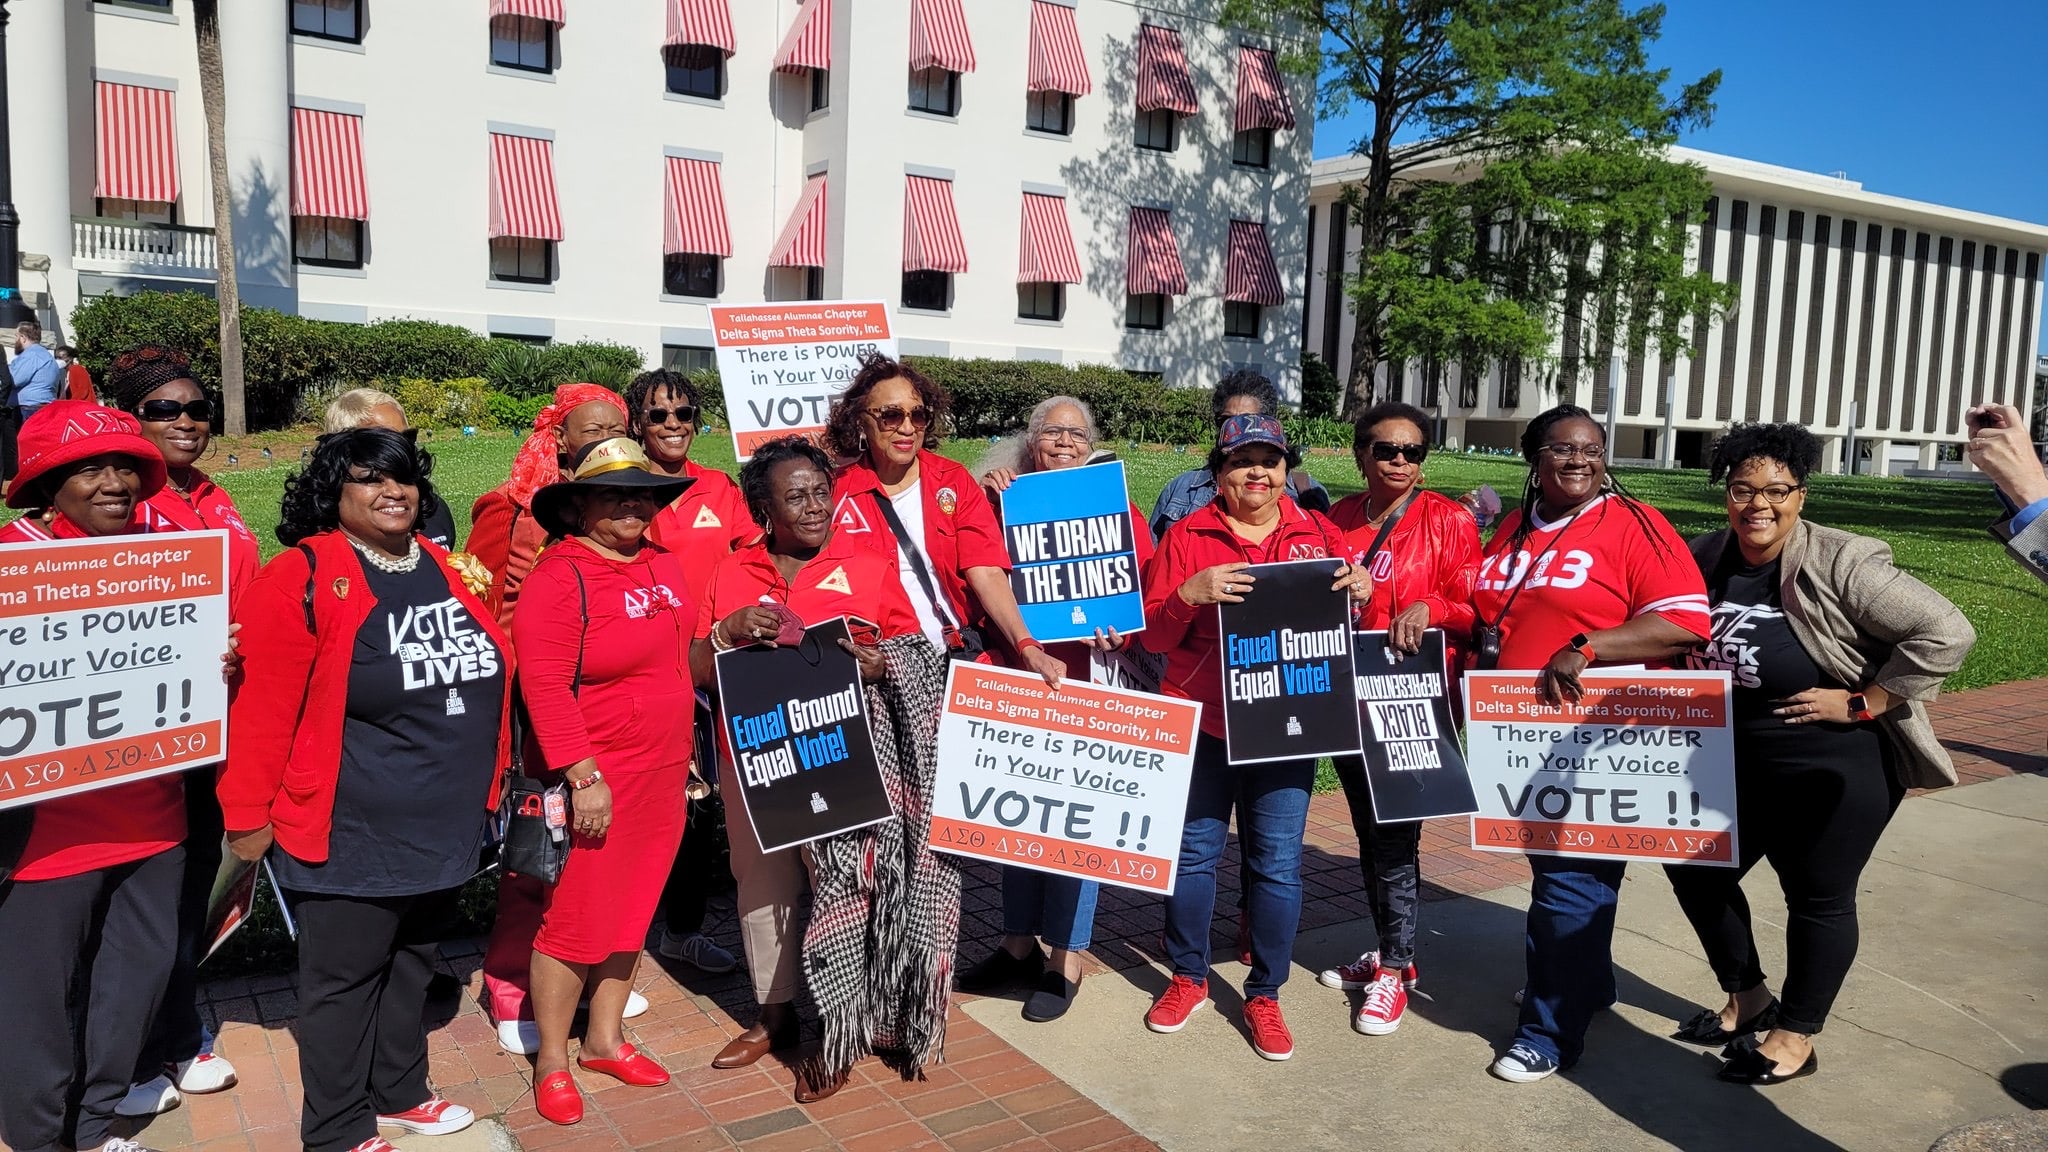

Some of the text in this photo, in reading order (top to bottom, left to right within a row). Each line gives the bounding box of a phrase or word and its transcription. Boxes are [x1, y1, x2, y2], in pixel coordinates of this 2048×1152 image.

[720, 323, 883, 341] Delta Sigma Theta Sorority, Inc.
[729, 309, 868, 323] Tallahassee Alumnae Chapter
[735, 347, 788, 364] There
[795, 346, 809, 360] is
[752, 366, 858, 385] in Your Voic
[1013, 514, 1123, 562] WE DRAW
[34, 558, 108, 573] Alumnae
[113, 548, 192, 568] Chapter
[1021, 555, 1132, 603] THE LINES
[33, 583, 91, 602] Theta
[96, 575, 176, 596] Sorority,
[181, 572, 212, 588] Inc.
[42, 616, 68, 642] is
[82, 603, 199, 637] POWER
[388, 597, 474, 655] VOTE
[1711, 600, 1784, 644] OTE
[0, 642, 182, 685] Your Voice.
[407, 632, 495, 661] BLACK
[1228, 630, 1278, 668] Equal
[1281, 623, 1347, 661] Ground
[1689, 640, 1760, 666] LACK
[402, 651, 498, 690] LIVES
[1230, 660, 1331, 704] Equal Vote!
[975, 678, 1168, 721] Tallahassee Alumnae Chapter
[1475, 701, 1513, 714] Delta
[1614, 703, 1681, 720] Sorority,
[1686, 705, 1714, 719] Inc.
[1491, 684, 1542, 695] Tallahas
[1626, 684, 1694, 699] Chapter
[0, 678, 192, 756] OTE !!
[732, 683, 860, 750] Equal Ground
[955, 693, 1180, 745] Delta Sigma Theta Sorority, Inc.
[1376, 703, 1430, 739] BLACK
[1492, 724, 1703, 748] There is POWER
[741, 725, 849, 788] Equal Vote!
[967, 720, 1165, 772] There is POWER
[1385, 740, 1442, 771] PROTECT
[1507, 750, 1689, 775] in Your Voice.
[975, 748, 1146, 797] in Your Voice.
[959, 781, 1151, 851] VOTE !!
[1496, 782, 1701, 827] VOTE !!
